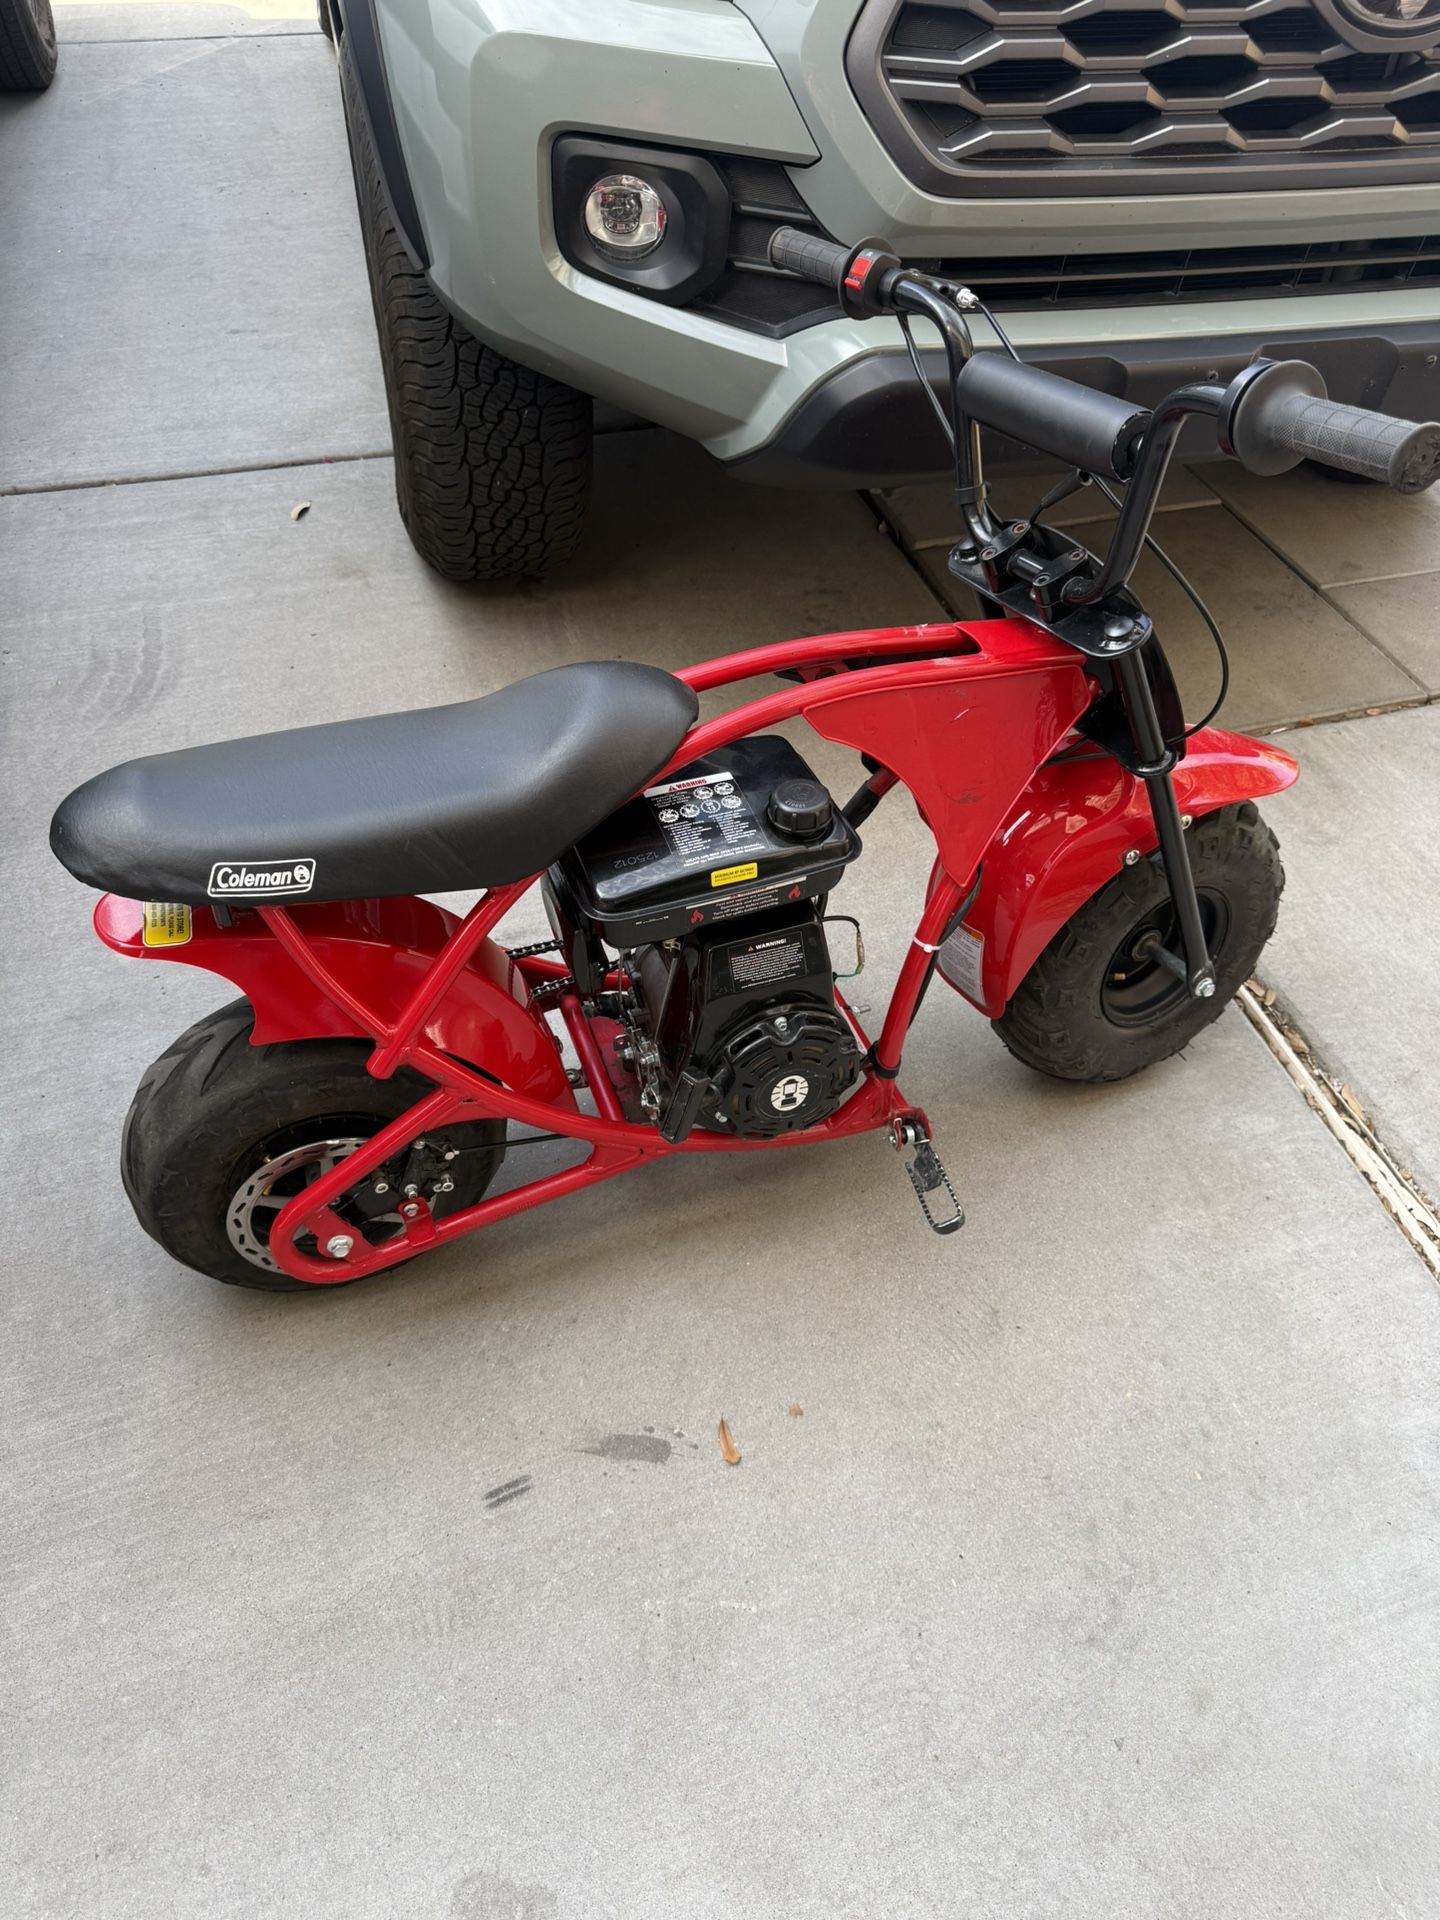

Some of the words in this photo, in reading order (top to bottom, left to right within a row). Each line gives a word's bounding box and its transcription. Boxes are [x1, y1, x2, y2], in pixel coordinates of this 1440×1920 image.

[676, 779, 706, 790] WARNING
[217, 867, 292, 888] Coleman
[755, 938, 787, 950] WARNING!
